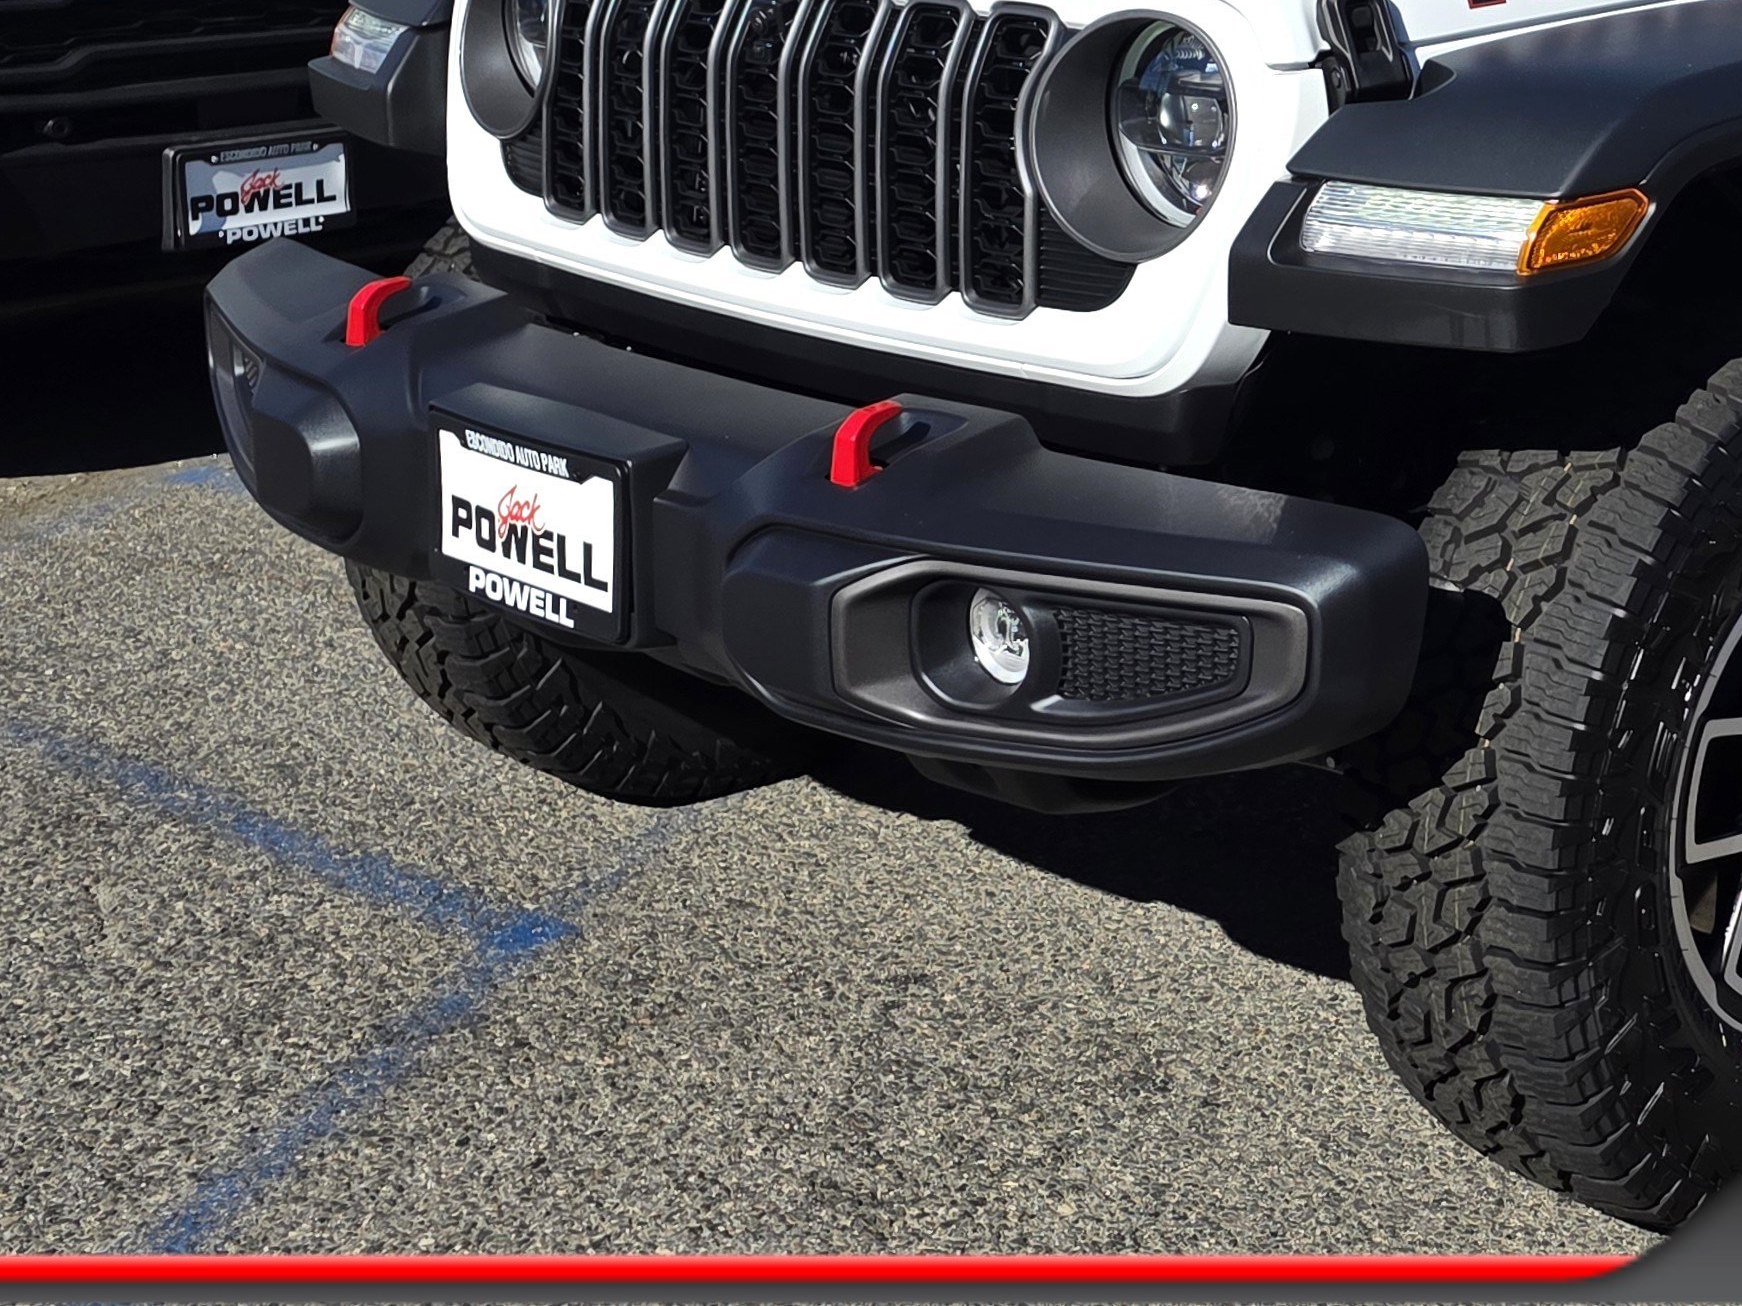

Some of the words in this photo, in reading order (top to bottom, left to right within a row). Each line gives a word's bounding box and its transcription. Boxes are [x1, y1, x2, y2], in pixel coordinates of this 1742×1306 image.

[190, 178, 337, 221] POWELL
[241, 167, 283, 205] Jack
[226, 215, 323, 245] POWELL
[515, 445, 540, 470] AUTO
[540, 453, 570, 478] PARK
[498, 485, 545, 538] Jack
[451, 494, 608, 592] POWELL
[468, 566, 574, 628] POWELL
